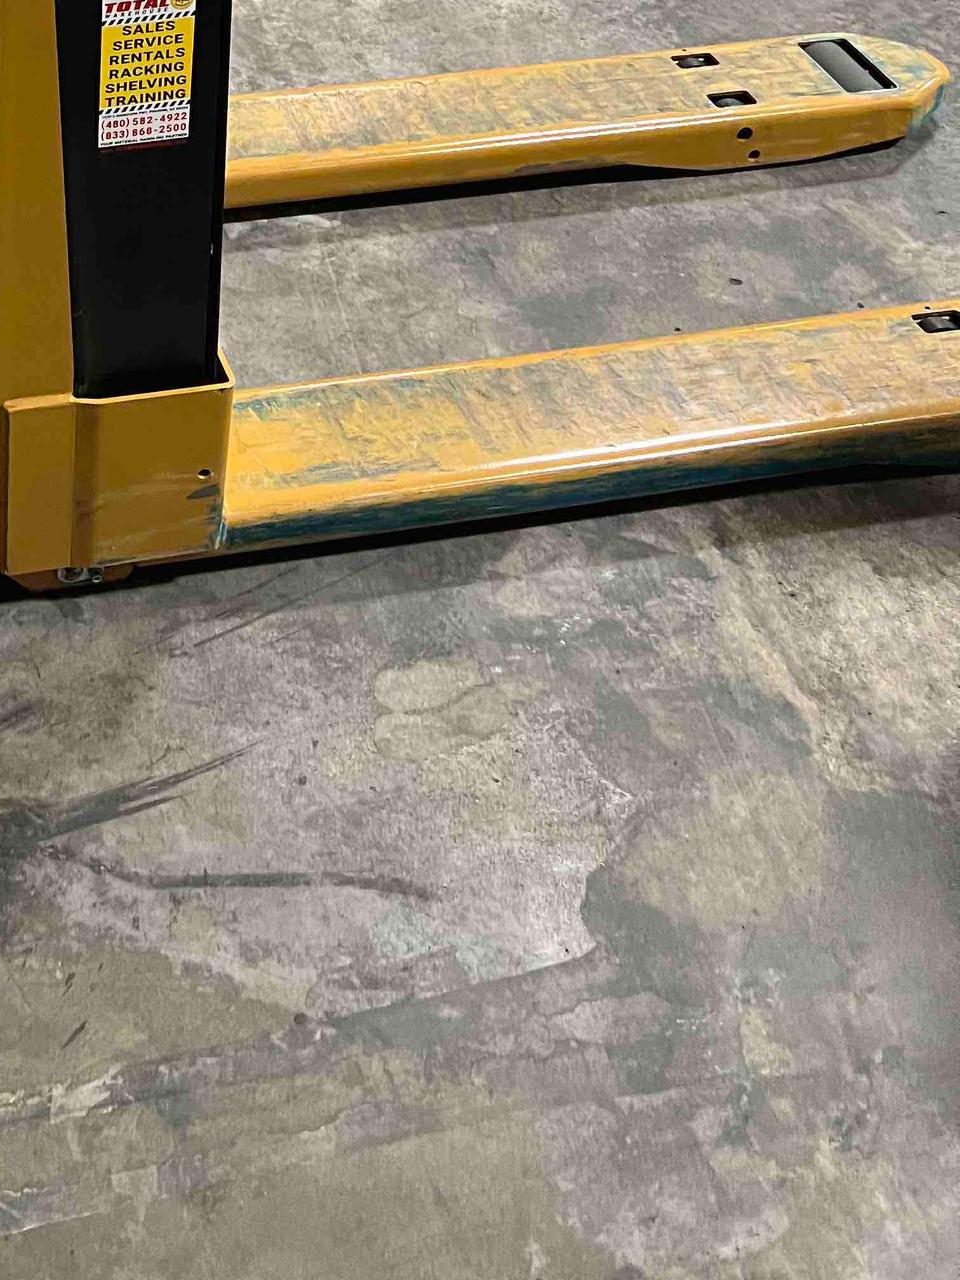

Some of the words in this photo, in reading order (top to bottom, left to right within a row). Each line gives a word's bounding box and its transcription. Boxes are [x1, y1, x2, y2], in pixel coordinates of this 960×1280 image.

[105, 7, 168, 18] WAREHOUSE
[122, 20, 176, 36] SALES
[112, 33, 184, 51] SERVICE
[109, 47, 186, 65] RENTALS
[109, 61, 184, 79] RACKING
[105, 75, 187, 94] SHELVING
[105, 88, 186, 107] TRAINING
[101, 118, 130, 131] (480)
[101, 128, 129, 141] (833)
